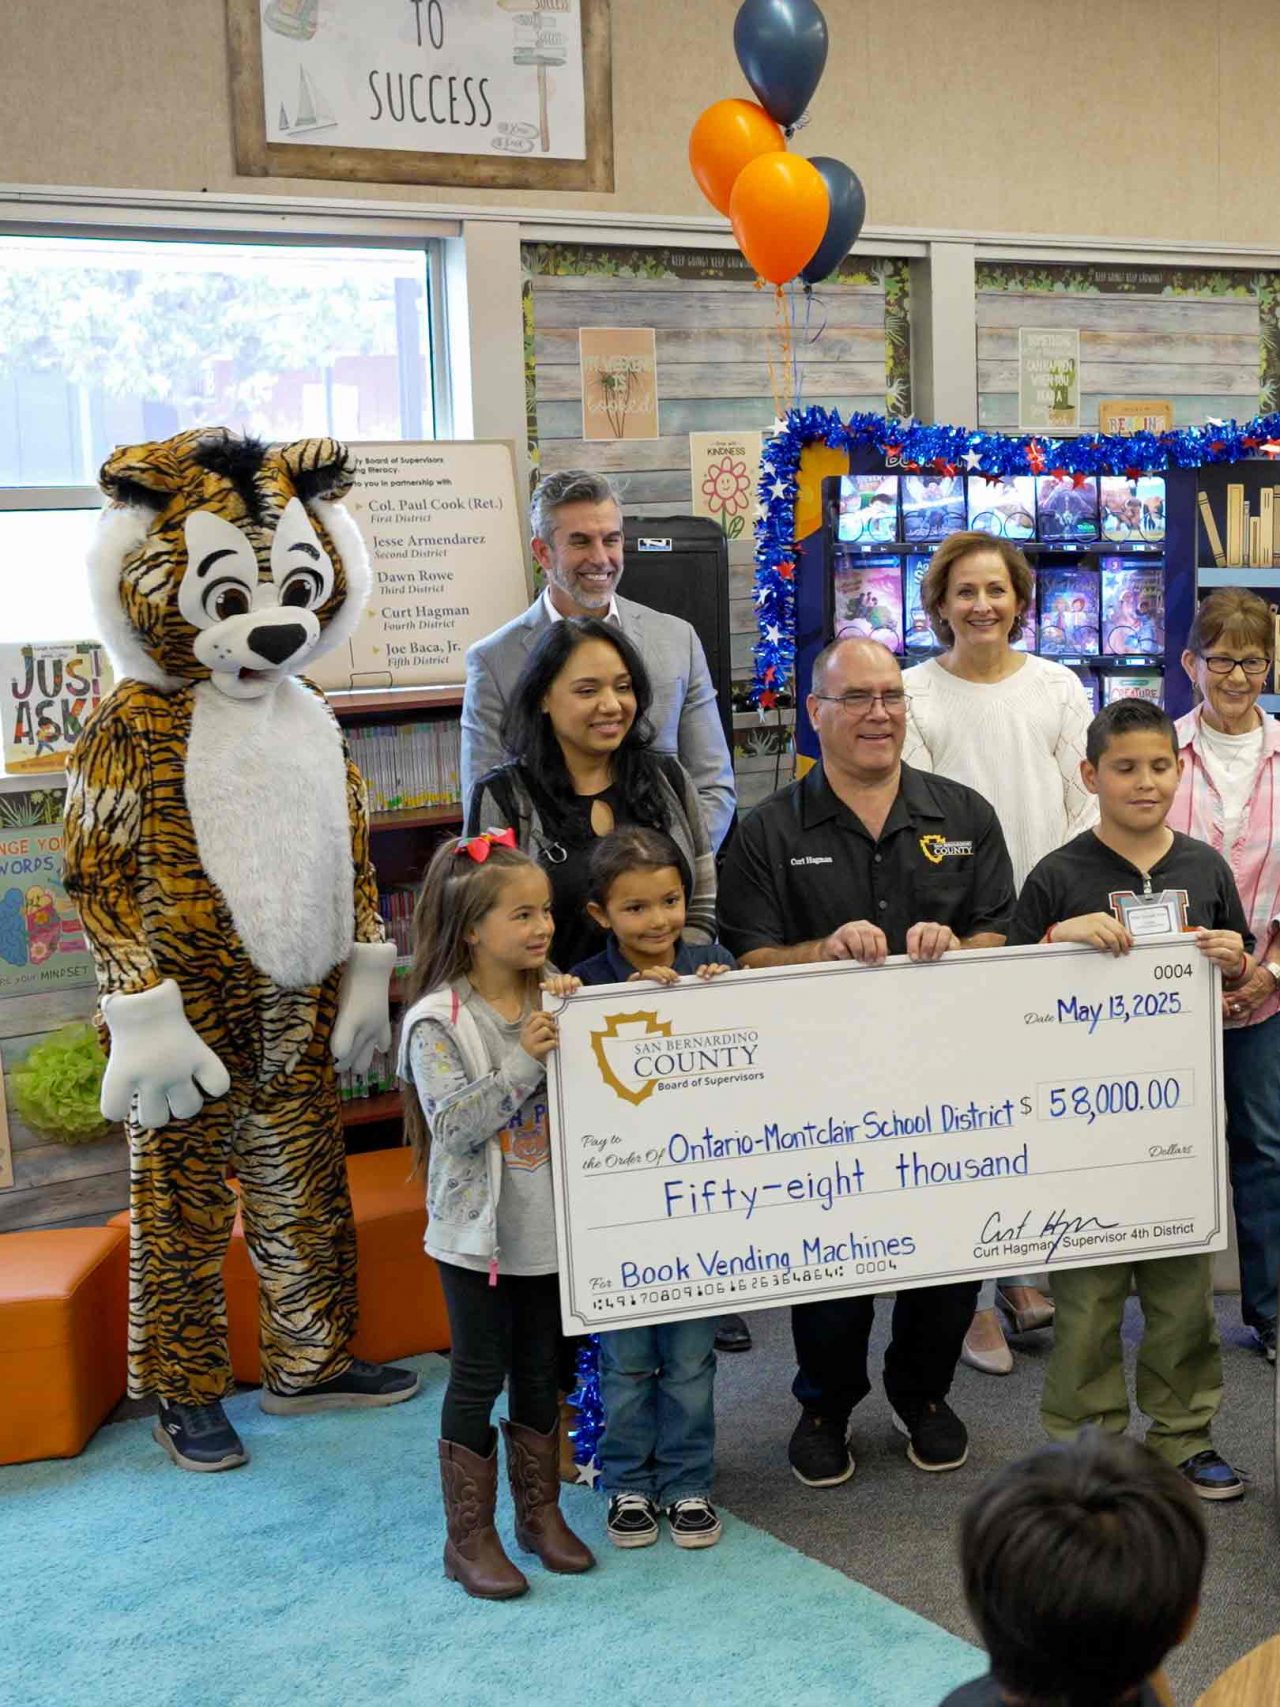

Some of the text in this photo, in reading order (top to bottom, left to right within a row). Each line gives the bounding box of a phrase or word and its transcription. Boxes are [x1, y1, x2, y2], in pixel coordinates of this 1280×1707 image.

[410, 0, 443, 49] TO
[369, 70, 492, 127] SUCCESS
[707, 447, 745, 456] KINDNESS
[365, 457, 389, 465] Board
[391, 457, 399, 465] of
[400, 456, 444, 466] Supervisors
[390, 479, 434, 488] partnership
[436, 479, 452, 487] with
[368, 496, 504, 512] Col. Paul Cook (Ret.)
[370, 514, 432, 524] First District
[373, 533, 486, 548] Jesse Armendarez
[374, 549, 448, 560] Second District
[377, 570, 455, 583] Dawn Rowe
[380, 584, 445, 595] Third District
[381, 604, 470, 619] Curt Hagman
[383, 620, 455, 631] Fourth District
[386, 640, 461, 656] Joe Baca, Jr.
[387, 656, 449, 669] Fifth District
[11, 644, 102, 700] JUST
[934, 846, 973, 856] COUNTY
[790, 856, 833, 866] Curt Hagman
[40, 965, 89, 981] MINDSET
[1154, 963, 1193, 980] 0004
[1024, 1012, 1055, 1025] Date
[1057, 996, 1103, 1035] May
[635, 1031, 758, 1056] SAN BERNARDINO
[634, 1044, 758, 1077] COUNTY
[658, 1071, 765, 1091] Board of Supervisors
[1050, 1077, 1180, 1125] 58,000.00
[669, 1099, 1014, 1163] Ontario-Montclair School District
[581, 1134, 622, 1150] Pay to
[582, 1147, 666, 1169] the Order Of
[1149, 1143, 1193, 1158] Dollars
[664, 1143, 1029, 1220] Fifty-eight thousand
[973, 1243, 1000, 1259] Curt
[1063, 1231, 1127, 1254] Supervisor
[1131, 1227, 1150, 1240] 4th
[1153, 1222, 1195, 1238] District
[621, 1232, 917, 1289] Book Vending Machines
[856, 1259, 897, 1275] 0004
[589, 1277, 612, 1291] For
